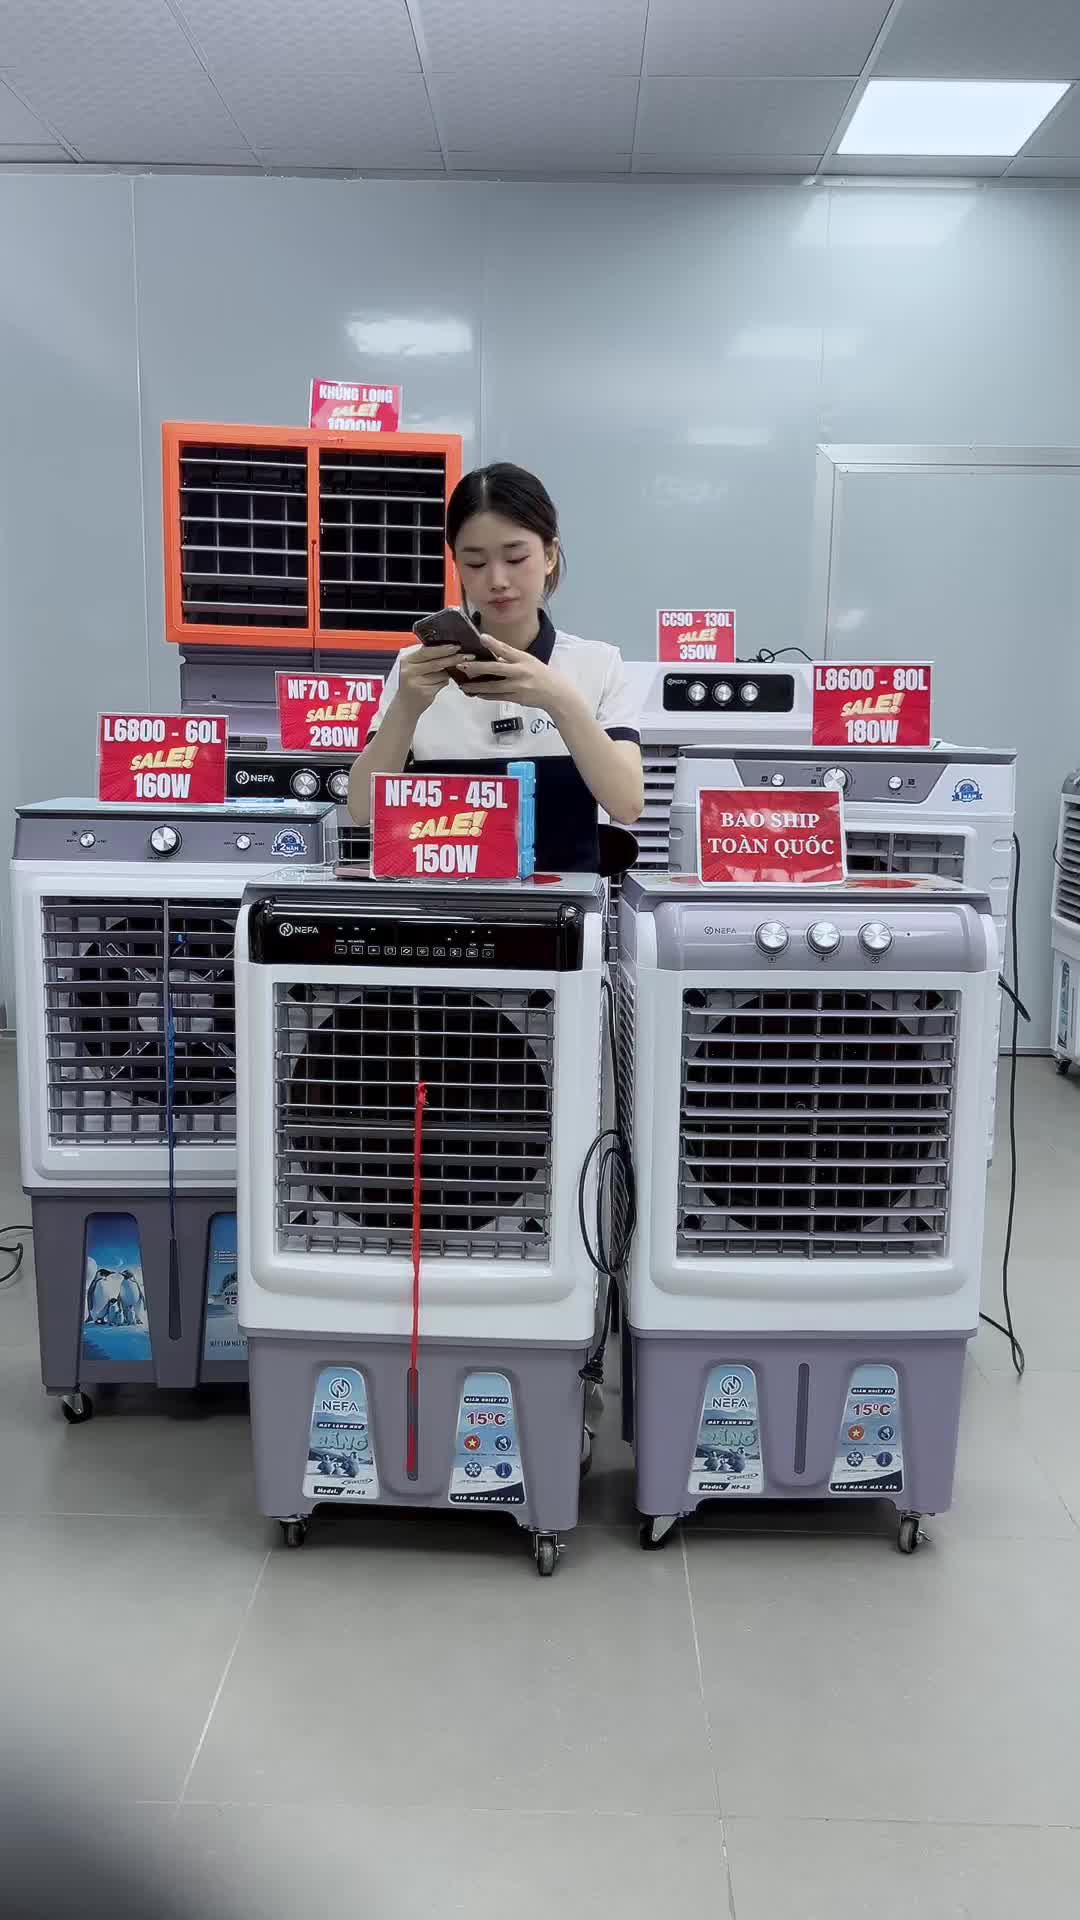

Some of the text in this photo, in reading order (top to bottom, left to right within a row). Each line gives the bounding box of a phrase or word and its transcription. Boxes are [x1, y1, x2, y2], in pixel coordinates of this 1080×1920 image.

[362, 388, 393, 404] LONG
[662, 612, 693, 627] CC90
[704, 612, 732, 627] 130L
[677, 627, 718, 644] SALE!
[680, 644, 717, 660] 350W
[816, 668, 874, 691] L8600
[893, 668, 928, 691] 80L
[288, 680, 329, 700] NF70
[346, 682, 376, 702] 70L
[305, 702, 361, 722] SALE!
[840, 692, 905, 717] SALE!
[104, 718, 166, 742] L6800
[185, 720, 221, 744] 60L
[310, 726, 359, 747] 280W
[845, 720, 899, 744] 180W
[129, 746, 199, 771] SALE!
[134, 773, 191, 798] 160W
[250, 774, 274, 782] NEFA
[385, 780, 442, 807] NF45
[465, 782, 508, 808] 45L
[408, 810, 488, 840] SALE!
[720, 812, 820, 828] BAO SHIP
[708, 834, 834, 858] TOÀN QUỐC
[412, 844, 479, 873] 150W
[322, 1400, 358, 1412] NEFA
[712, 1398, 748, 1408] NEFA
